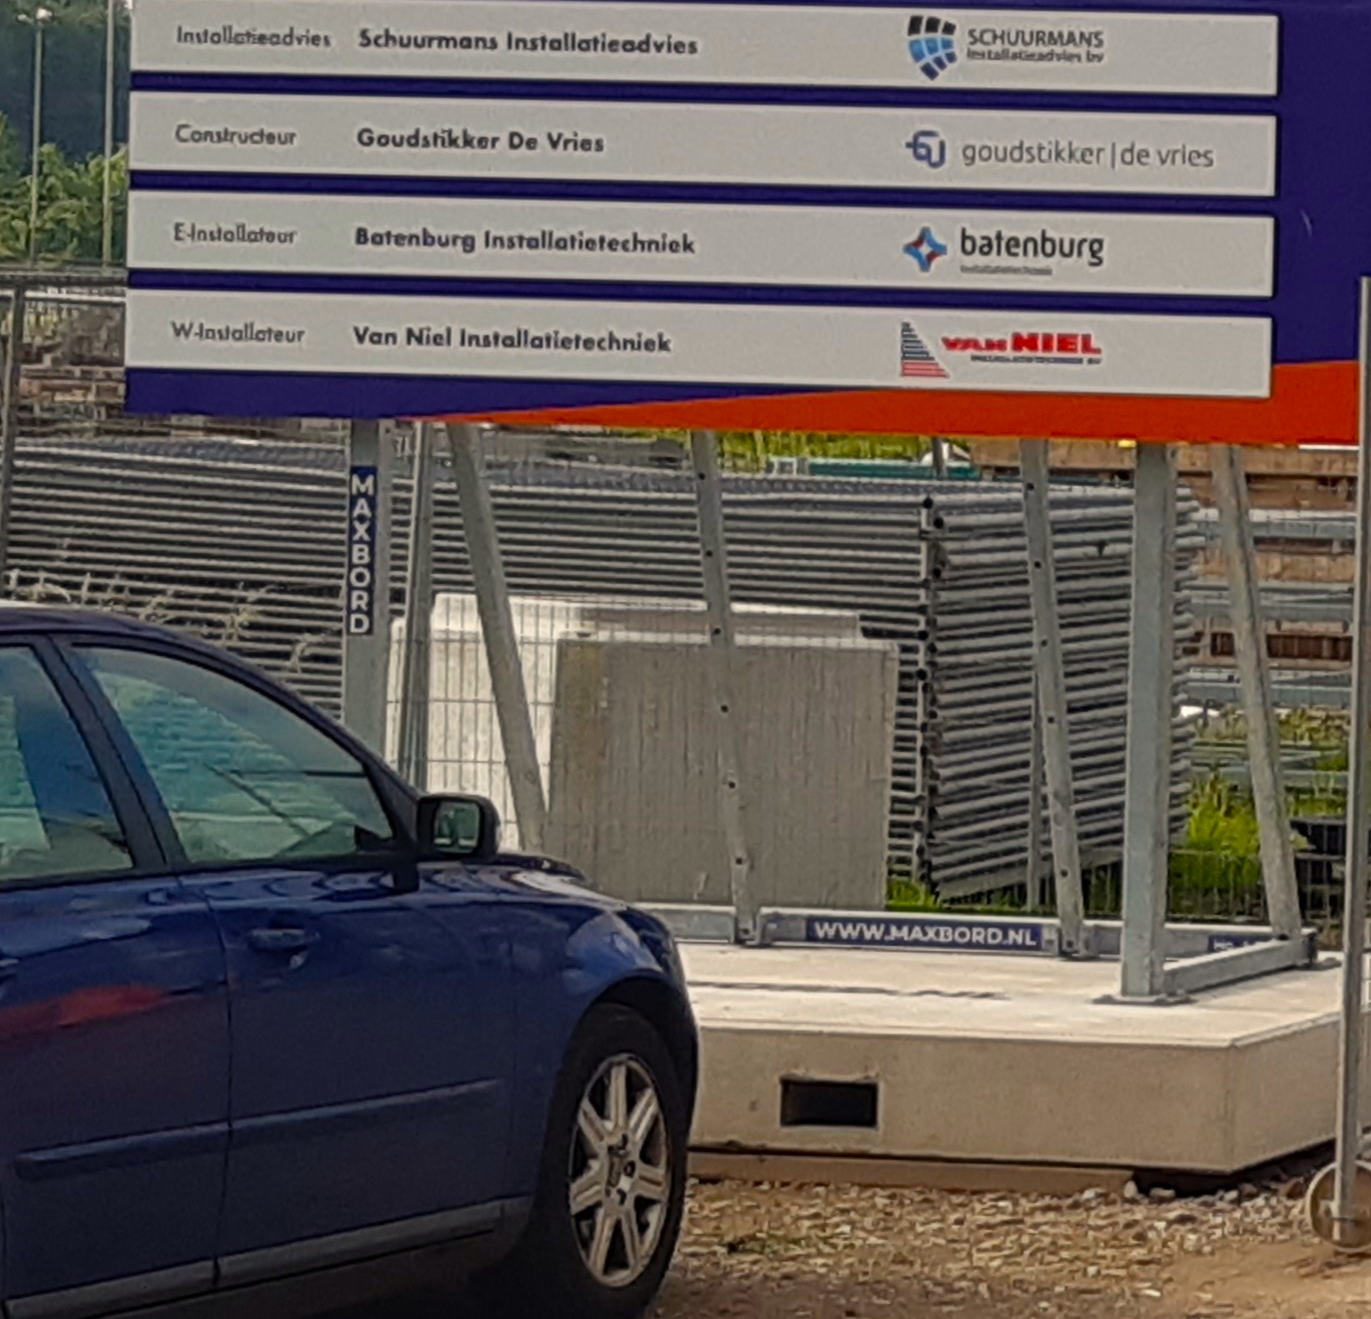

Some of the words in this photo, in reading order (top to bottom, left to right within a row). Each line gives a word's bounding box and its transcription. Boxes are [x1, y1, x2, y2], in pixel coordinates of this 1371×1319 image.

[177, 25, 331, 47] Installatieadvies
[359, 28, 498, 50] Schuurmans
[507, 32, 698, 54] Installatieadvies
[968, 28, 1104, 48] SCHUURMANS
[175, 123, 296, 145] Constructeur
[357, 128, 500, 150] Goudstikker
[508, 131, 538, 151] De
[547, 132, 604, 152] Vries
[1157, 145, 1214, 168] vries
[174, 222, 295, 244] E-Installateur
[355, 227, 476, 254] Batenburg
[484, 230, 695, 254] Installatietechniek
[960, 227, 1104, 267] batenburg
[171, 322, 305, 343] W-Installateur
[353, 326, 398, 345] Van
[406, 327, 451, 346] Niel
[459, 328, 671, 352] Installatietechniek
[1011, 332, 1102, 354] NIEL
[350, 473, 375, 633] MAXBORD
[813, 920, 1038, 947] WWW.MAXBORD.NL
